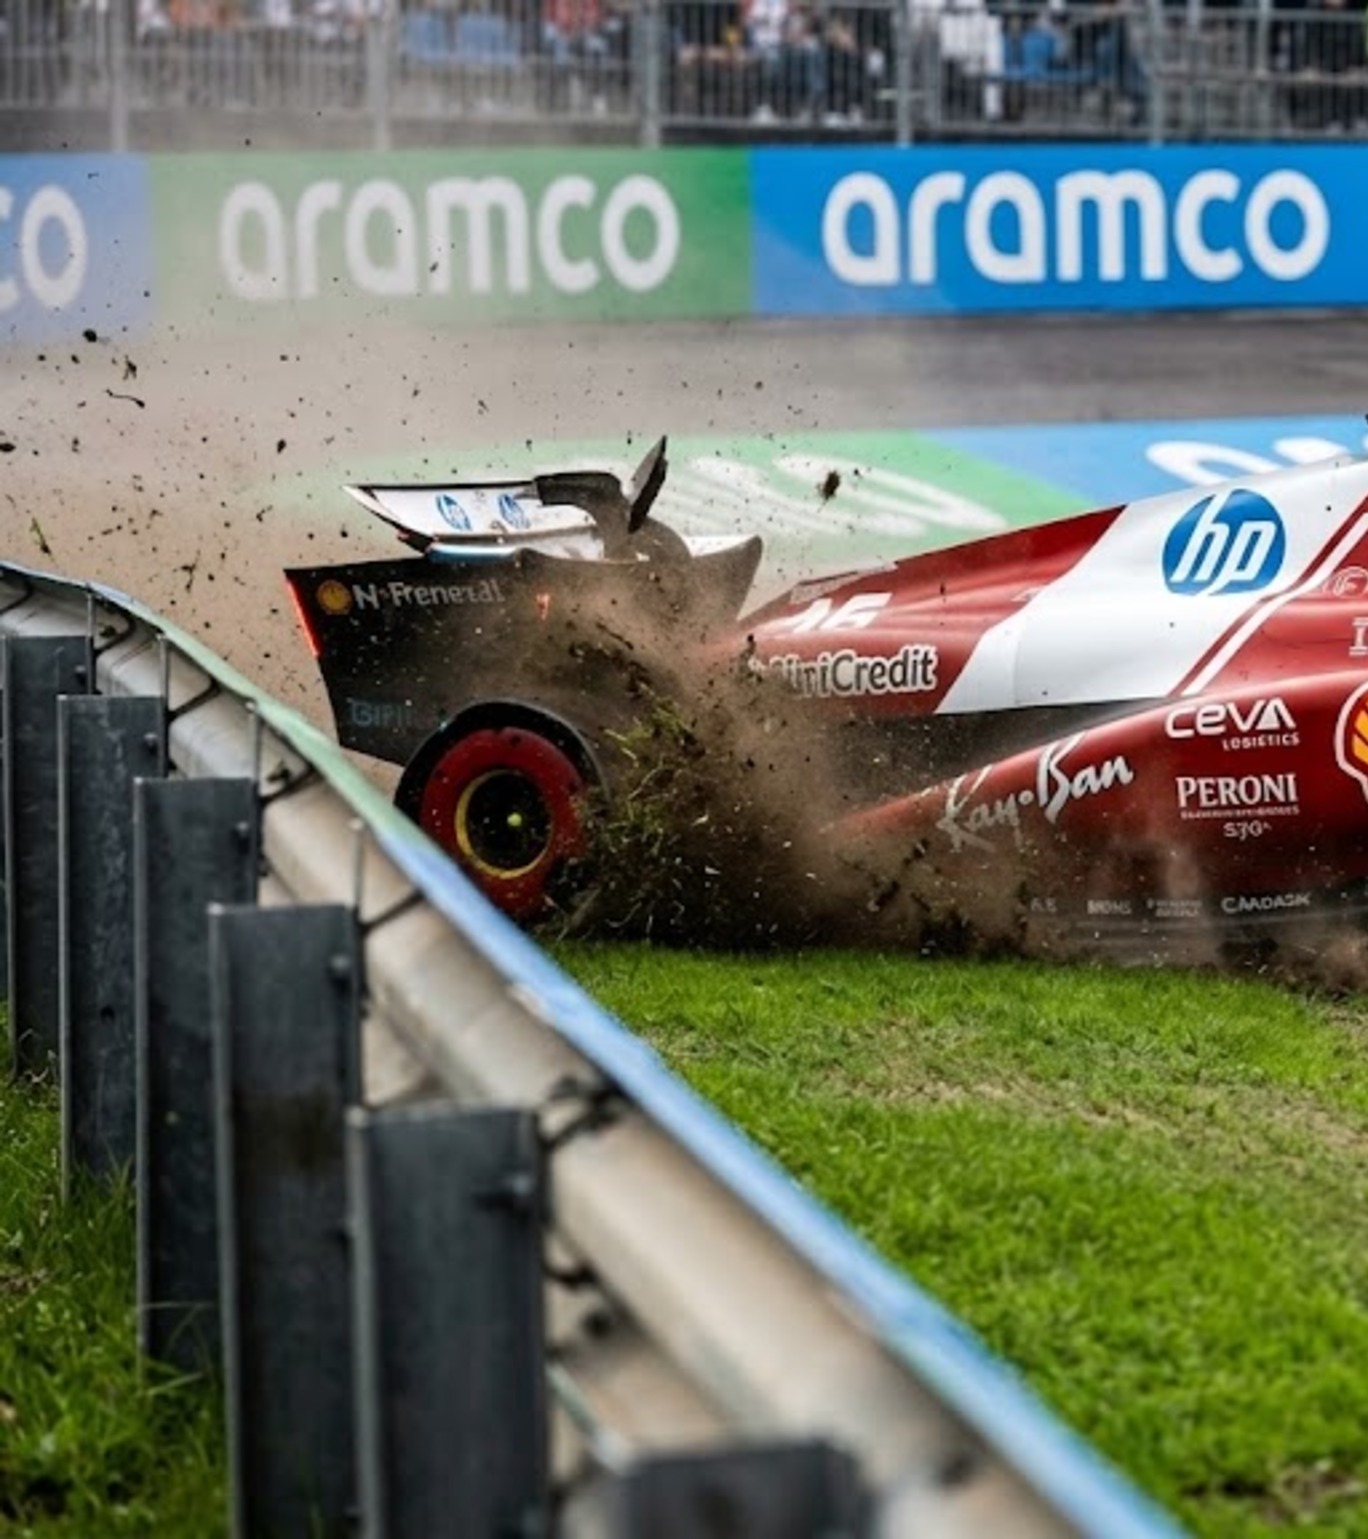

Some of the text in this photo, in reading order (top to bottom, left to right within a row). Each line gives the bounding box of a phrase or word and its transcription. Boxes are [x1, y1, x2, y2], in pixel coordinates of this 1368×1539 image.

[0, 183, 88, 310] o
[219, 174, 680, 300] aramco
[822, 169, 1330, 286] aramco
[1167, 487, 1280, 596] hp
[1175, 773, 1299, 808] PERONI
